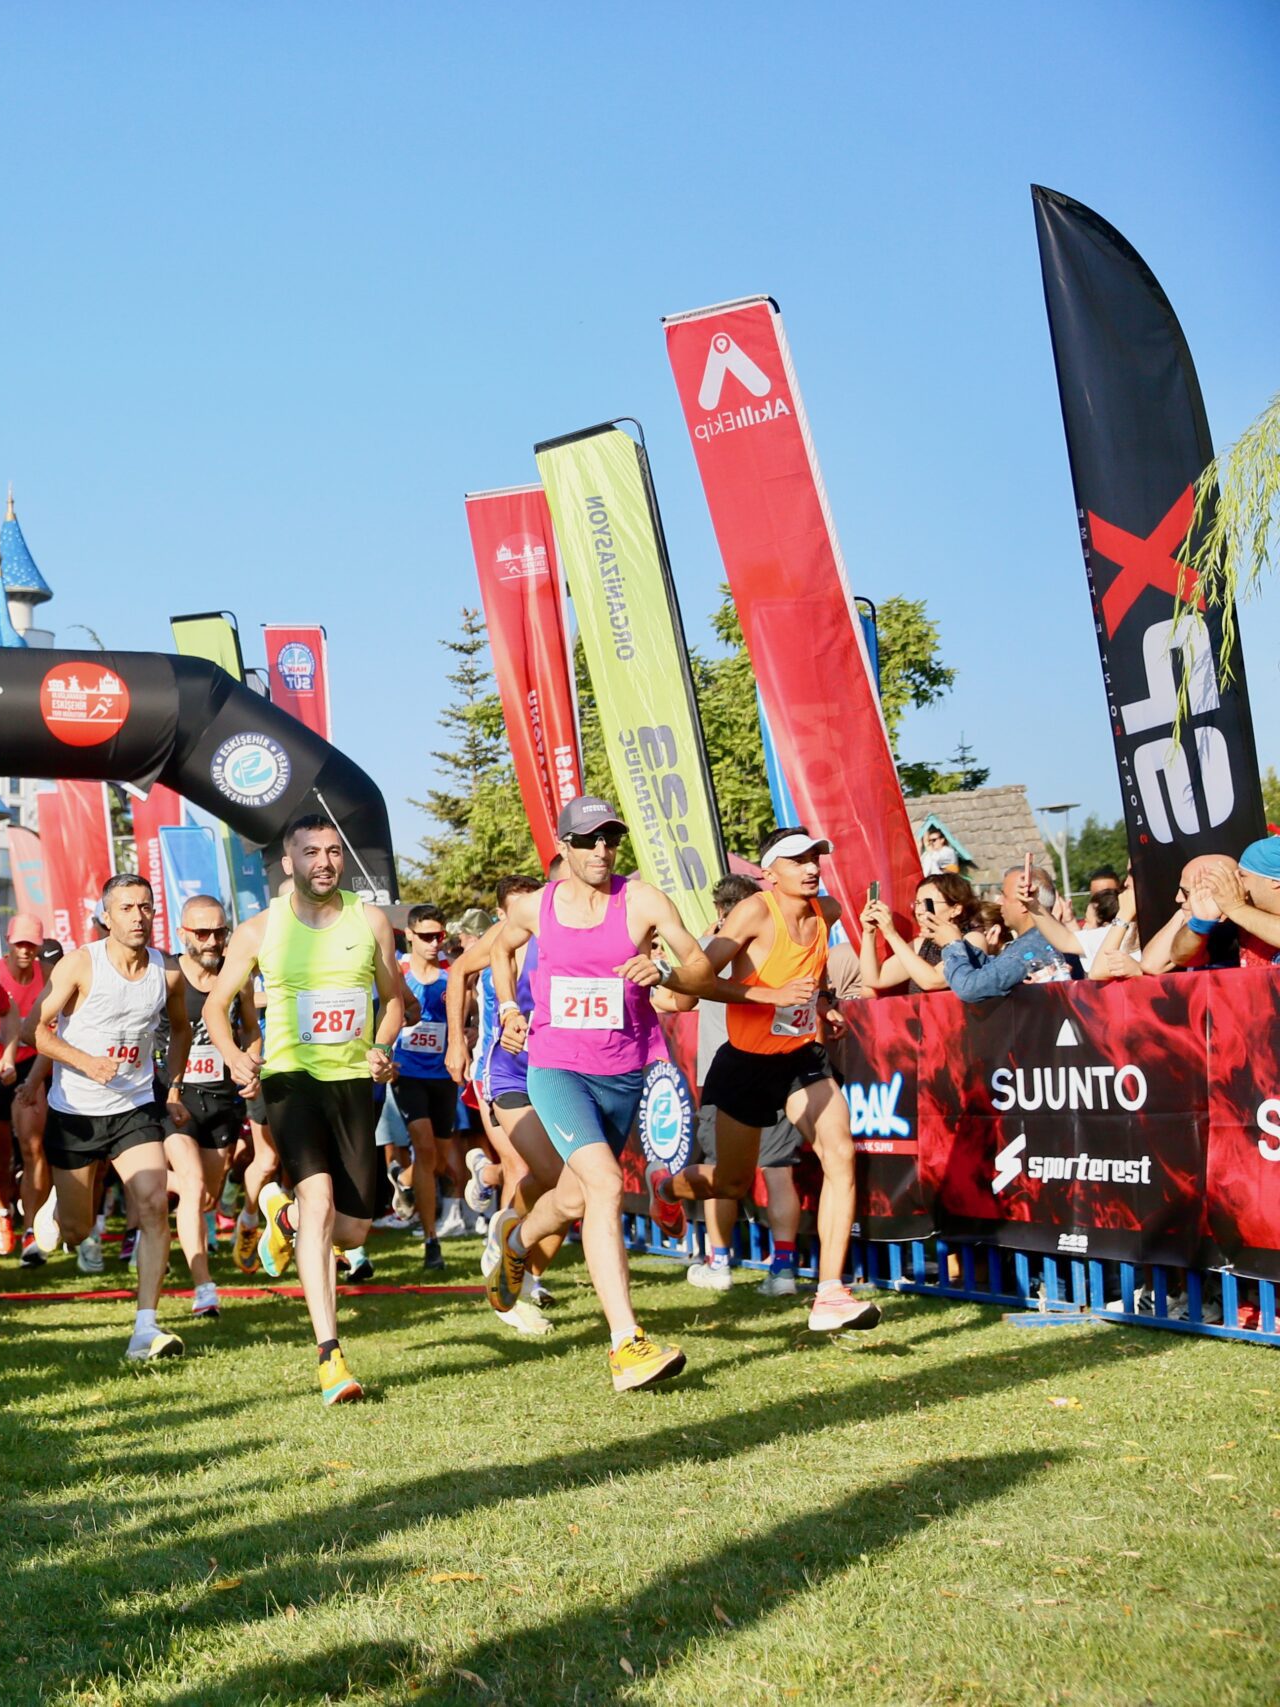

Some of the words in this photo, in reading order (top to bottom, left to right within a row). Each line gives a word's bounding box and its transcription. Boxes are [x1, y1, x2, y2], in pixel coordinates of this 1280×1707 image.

[564, 996, 608, 1017] 215
[312, 1008, 356, 1033] 287
[410, 1032, 437, 1047] 255
[991, 1064, 1148, 1112] SUUNTO
[1028, 1152, 1152, 1184] sporterest
